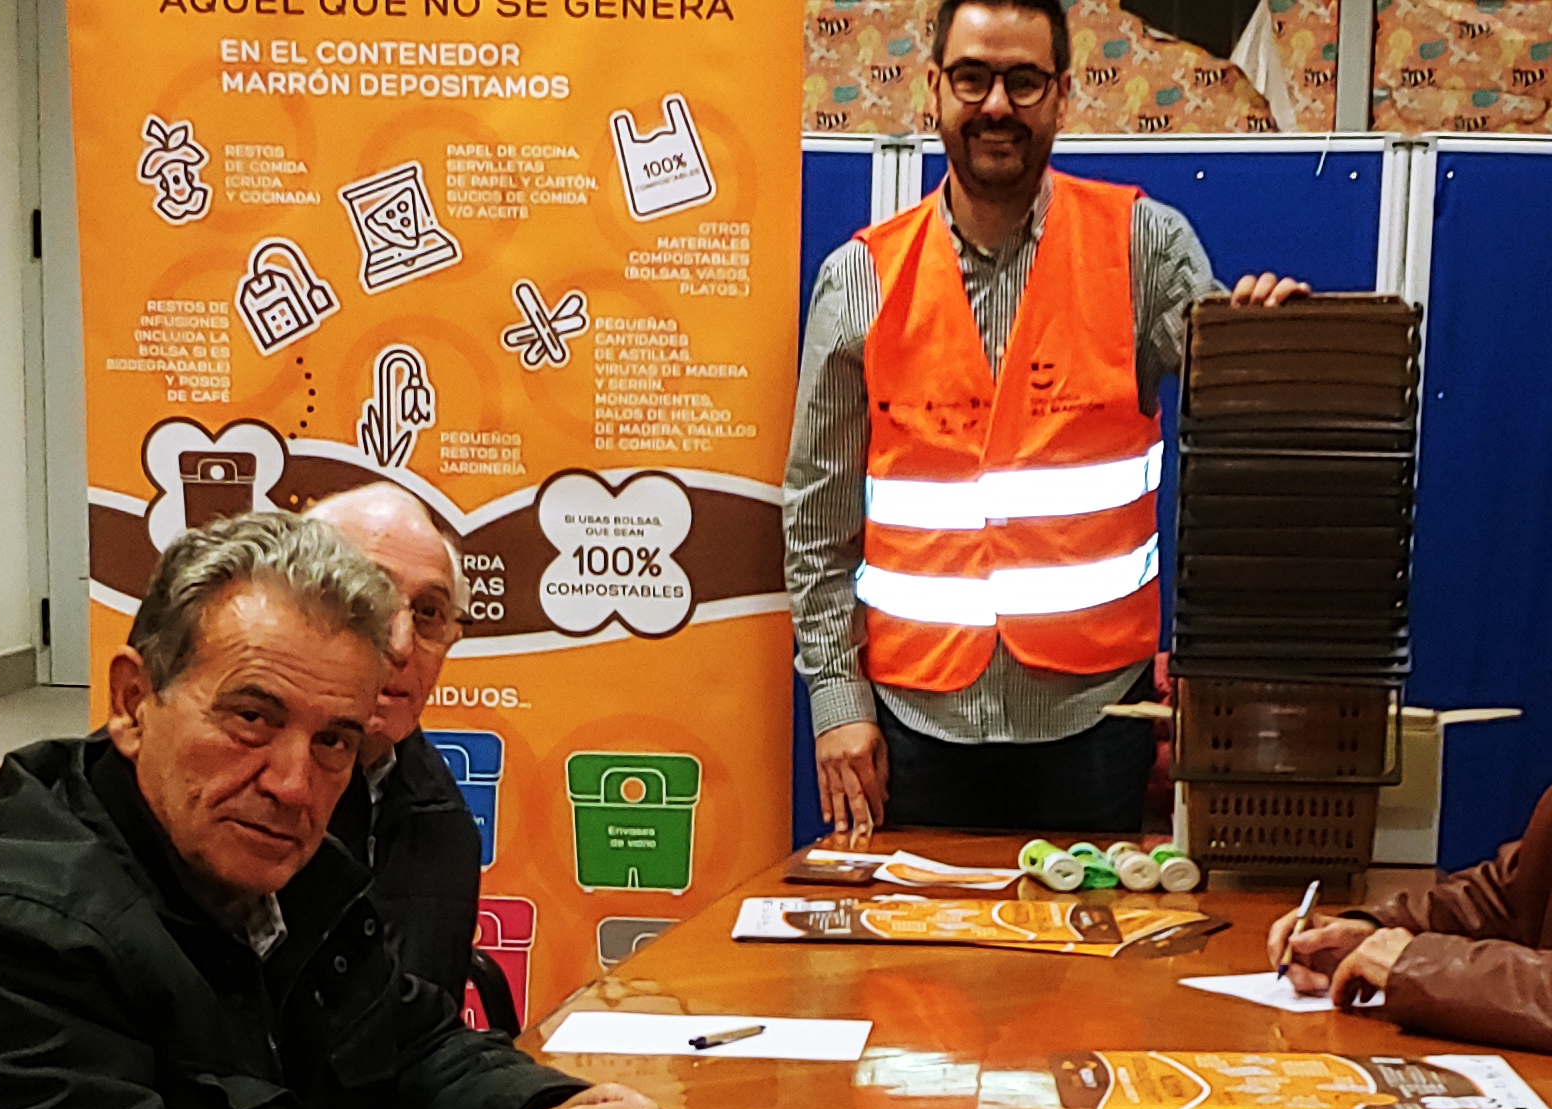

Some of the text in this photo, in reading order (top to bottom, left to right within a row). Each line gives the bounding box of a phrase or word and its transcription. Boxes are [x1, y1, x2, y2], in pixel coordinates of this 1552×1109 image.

[497, 0, 548, 18] SE
[564, 0, 735, 20] GENERA
[220, 39, 520, 67] EN EL CONTENEDOR
[221, 68, 570, 99] MARRÓN DEPOSITAMOS
[225, 144, 285, 158] RESTOS
[447, 144, 493, 157] PAPEL
[497, 145, 516, 157] DE
[225, 160, 308, 174] DE COMIDA
[447, 159, 545, 172] SERVILLETAS
[643, 152, 687, 180] 100%
[447, 174, 465, 187] DE
[471, 175, 518, 188] PAPEL
[521, 176, 530, 188] Y
[226, 190, 321, 205] Y COCINADA)
[506, 191, 525, 203] DE
[530, 191, 587, 204] COMIDA
[477, 206, 529, 219] ACEITE
[699, 222, 750, 236] OTROS
[657, 236, 750, 251] MATERIALES
[629, 251, 750, 266] COMPOSTABLES
[147, 300, 229, 314] RESTOS DE
[140, 314, 230, 329] INFUSIONES
[595, 316, 677, 332] PEQUEÑAS
[134, 329, 230, 343] (INCLUIDA LA
[595, 333, 689, 347] CANTIDADES
[139, 344, 230, 359] BOLSA SI ES
[595, 349, 614, 361] DE
[106, 358, 230, 374] BIODEGRADABLE)
[595, 364, 748, 378] VIRUTAS DE MADERA
[165, 374, 231, 388] Y POSOS
[595, 379, 604, 390] Y
[167, 388, 230, 403] DE CAFÉ
[595, 408, 731, 422] PALOS DE HELADO
[595, 422, 614, 435] DE
[688, 424, 756, 437] PALILLOS
[440, 431, 521, 446] PEQUEÑOS
[595, 437, 614, 450] DE
[441, 446, 521, 460] RESTOS DE
[439, 460, 526, 475] JARDINERÍA
[579, 515, 610, 524] USAS
[462, 554, 505, 571] RDA
[573, 544, 662, 577] 100%
[546, 582, 684, 598] COMPOSTABLES
